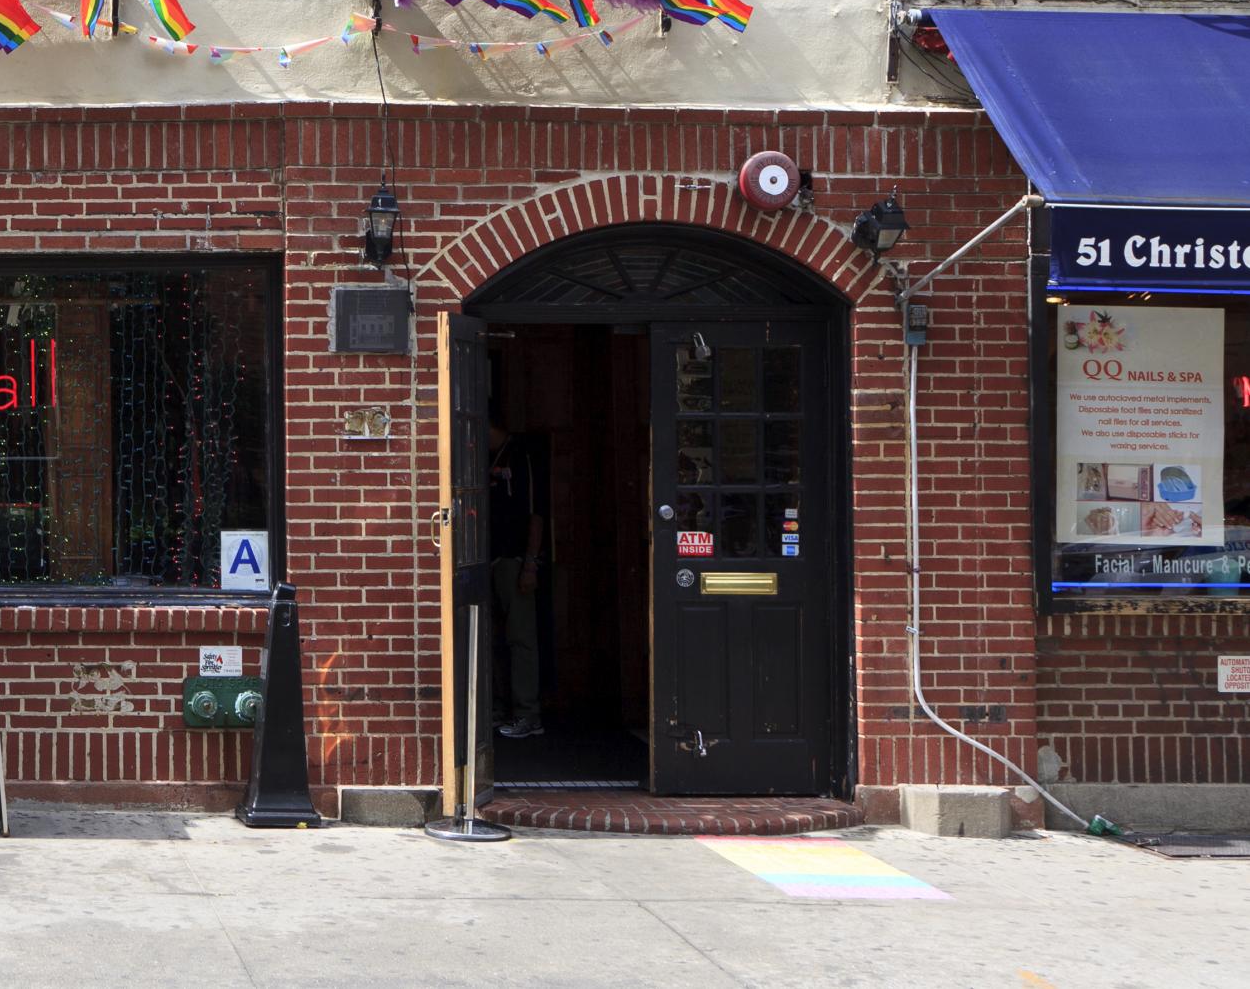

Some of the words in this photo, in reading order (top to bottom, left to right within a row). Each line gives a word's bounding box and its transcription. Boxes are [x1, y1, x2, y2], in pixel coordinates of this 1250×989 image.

[1076, 237, 1112, 267] 51
[1082, 359, 1123, 381] QQ
[1128, 371, 1164, 382] NAILS
[1167, 371, 1177, 382] &
[1180, 371, 1203, 383] SPA
[1070, 393, 1082, 401] We
[1097, 394, 1142, 403] autoclaved
[1167, 395, 1212, 404] implements.
[1078, 405, 1119, 415] Disposable
[1120, 406, 1136, 414] foot
[1153, 407, 1169, 415] and
[1170, 408, 1203, 416] sanitized
[1098, 418, 1112, 426] nail
[1113, 418, 1128, 426] files
[1129, 418, 1140, 426] for
[1141, 418, 1150, 426] all
[1151, 419, 1182, 427] services.
[1081, 428, 1093, 437] We
[1095, 429, 1110, 437] also
[1126, 429, 1167, 439] disposable
[1168, 431, 1188, 439] sticks
[1189, 431, 1200, 439] for
[1110, 442, 1137, 451] waxing
[679, 532, 711, 544] ATM
[679, 546, 712, 554] INSIDE
[229, 539, 261, 574] A
[1095, 554, 1135, 574] Facial
[1152, 554, 1213, 574] Manicure
[1221, 555, 1231, 574] &
